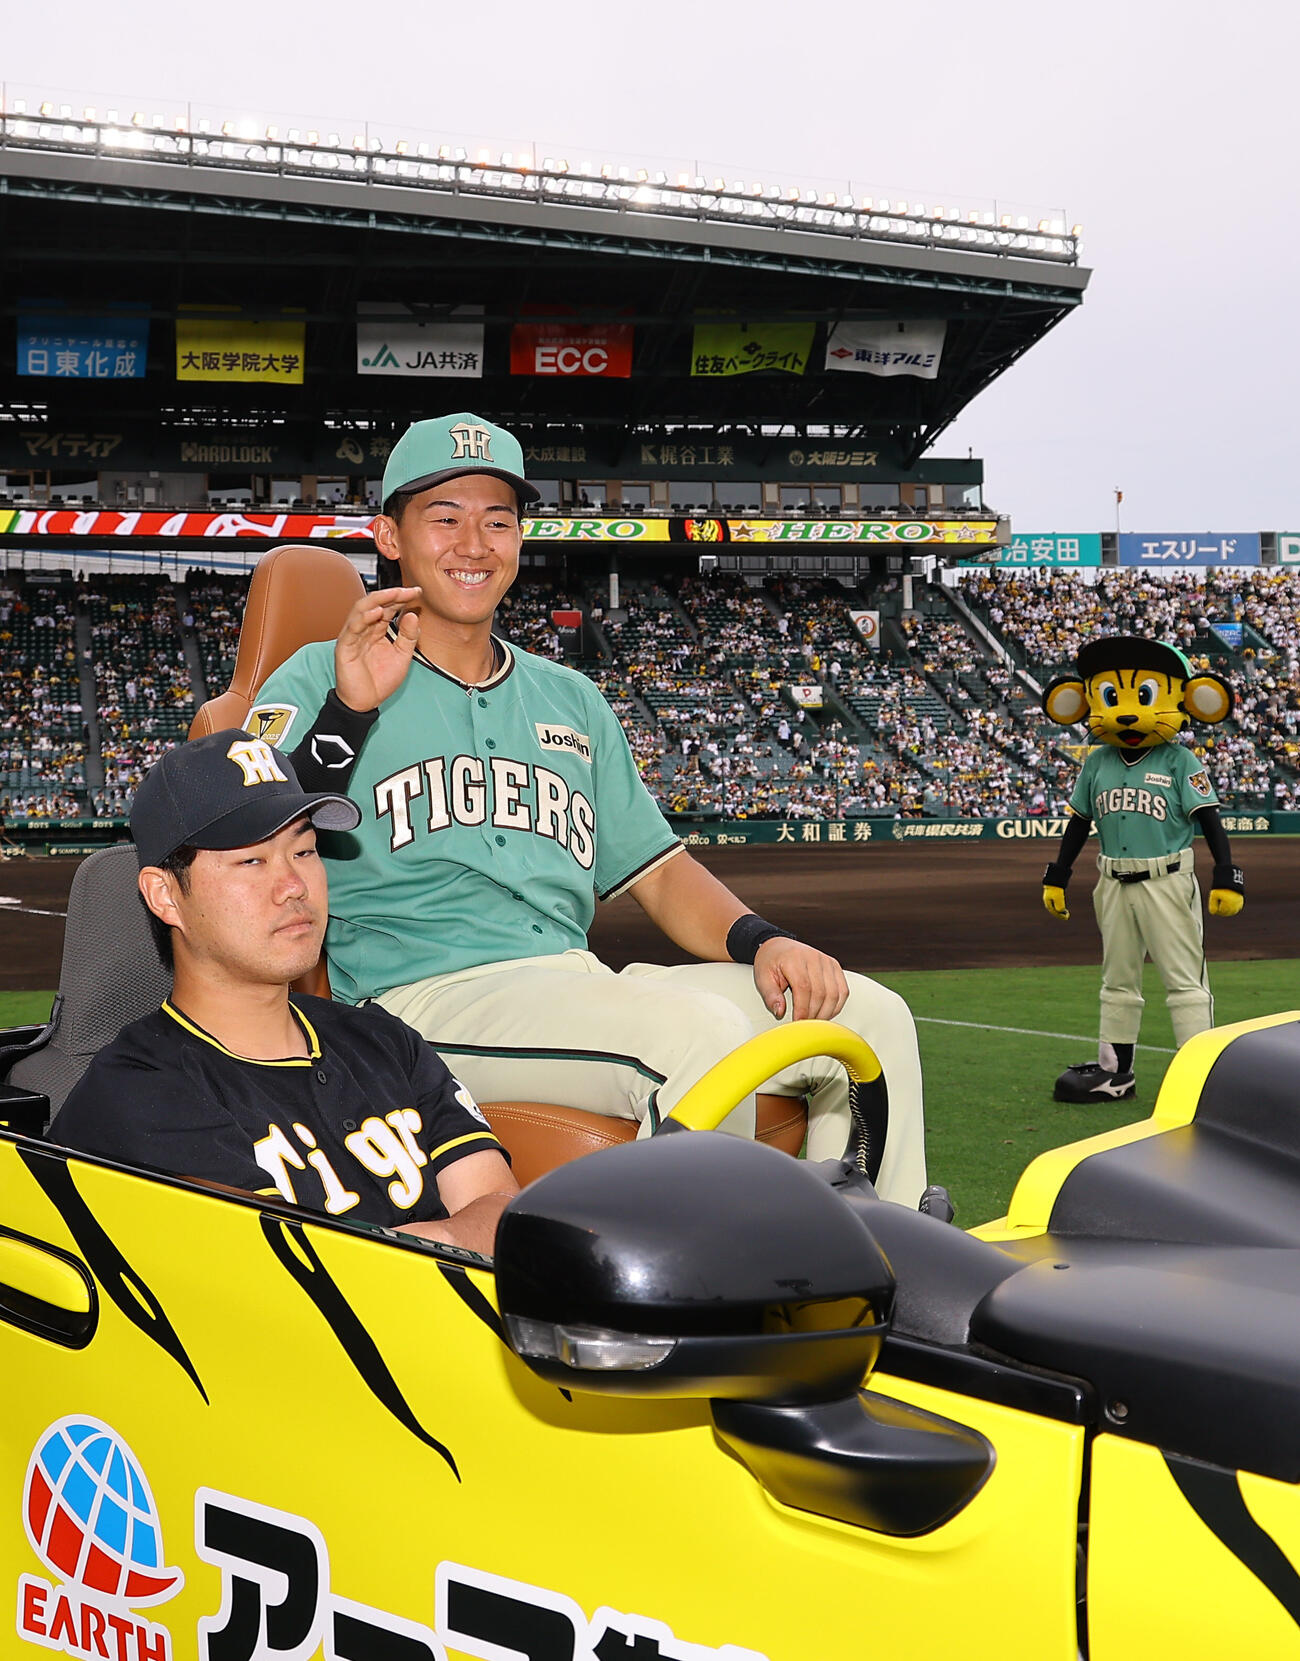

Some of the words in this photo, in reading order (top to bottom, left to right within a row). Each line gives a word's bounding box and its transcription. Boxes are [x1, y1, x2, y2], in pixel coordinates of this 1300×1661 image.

[27, 349, 136, 377] 日東化成
[181, 351, 299, 373] 大阪学院大学
[406, 351, 479, 370] JA共済
[535, 346, 608, 373] ECC
[854, 350, 936, 368] 東洋アルミ
[181, 442, 273, 463] HARDLOCK
[521, 520, 645, 538] ERO
[774, 522, 932, 541] HERO
[990, 537, 1080, 562] 治安田
[1141, 539, 1237, 560] エスリード
[540, 729, 590, 757] Joshin
[373, 754, 596, 871] TIGERS
[1096, 787, 1167, 822] TIGERS
[776, 822, 872, 843] 大和証券
[1221, 816, 1270, 831] 塚商会
[23, 1583, 166, 1661] EARTH
